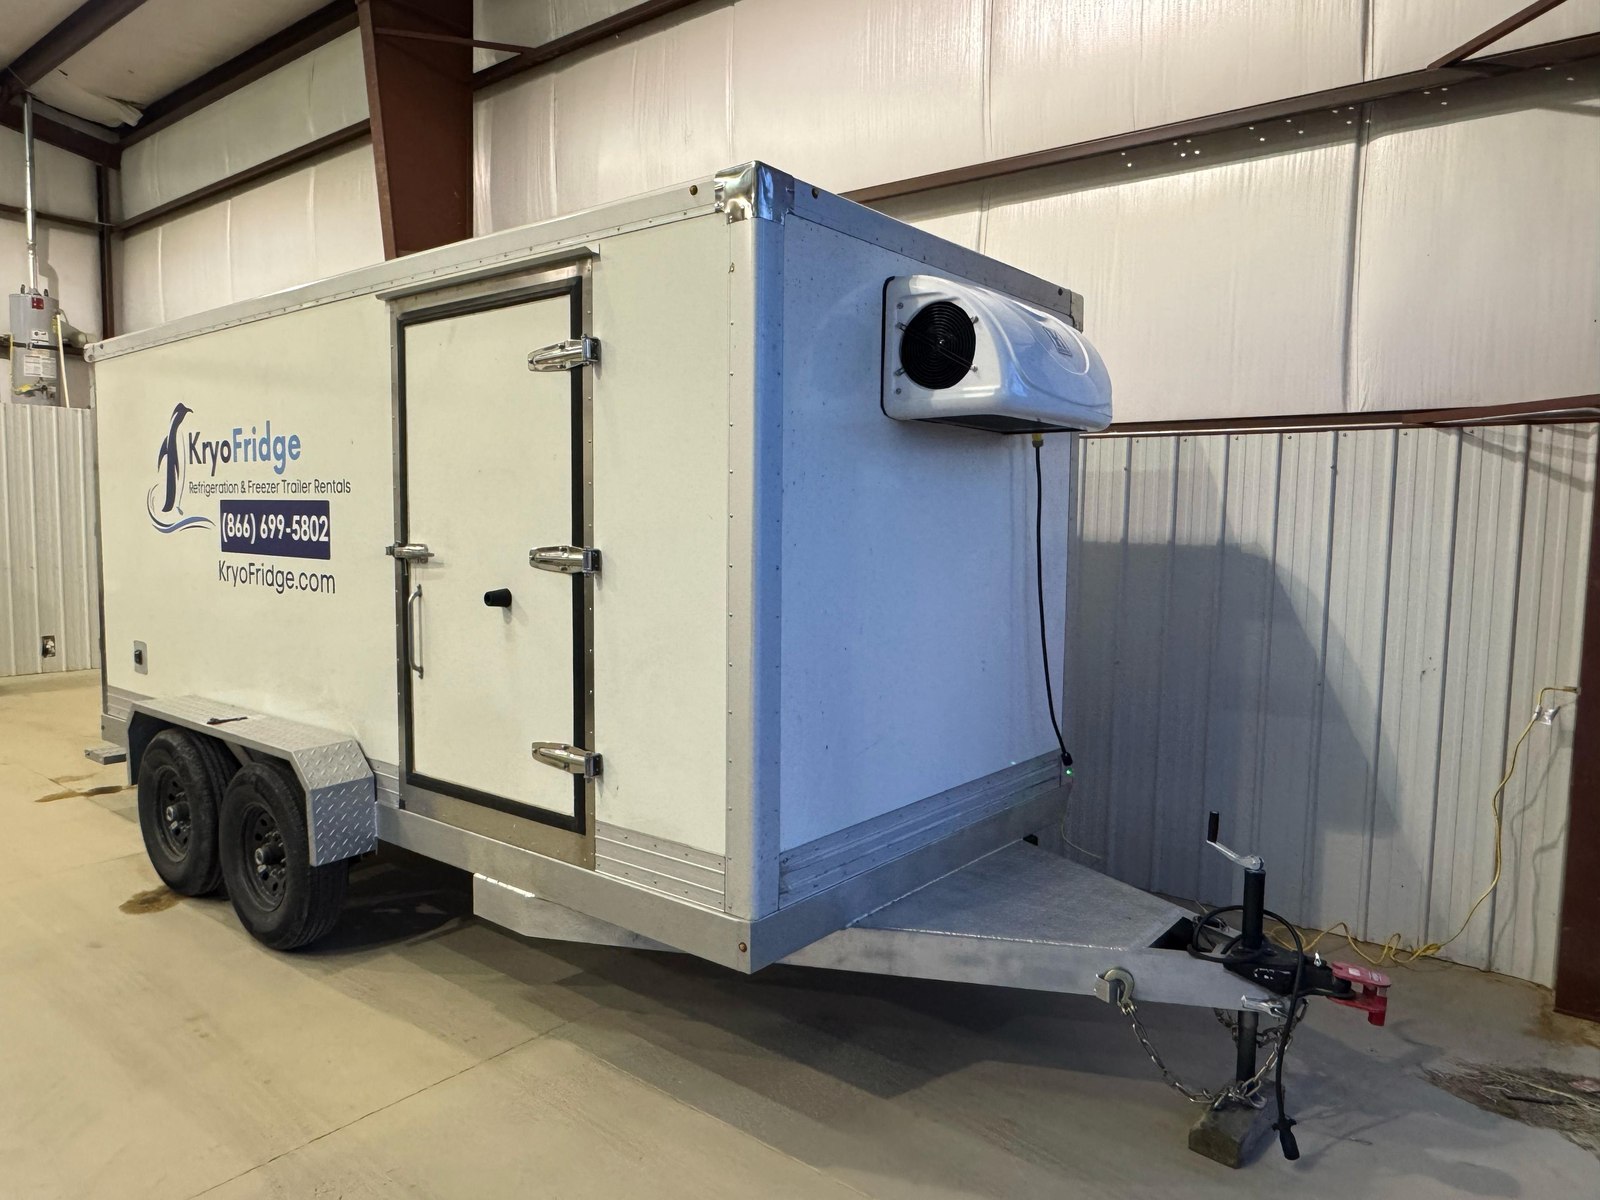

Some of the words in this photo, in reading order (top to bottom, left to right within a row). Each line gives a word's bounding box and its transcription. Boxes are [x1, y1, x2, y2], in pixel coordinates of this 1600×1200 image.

[188, 420, 302, 477] KryoFridge
[188, 480, 239, 497] Refrigeration
[240, 480, 246, 494] &
[247, 480, 280, 494] Freezer
[281, 479, 312, 494] Trailer
[314, 478, 352, 494] Rentals
[222, 512, 256, 545] (866)
[259, 514, 329, 542] 699-5802
[218, 560, 336, 594] KryoFridge.com
